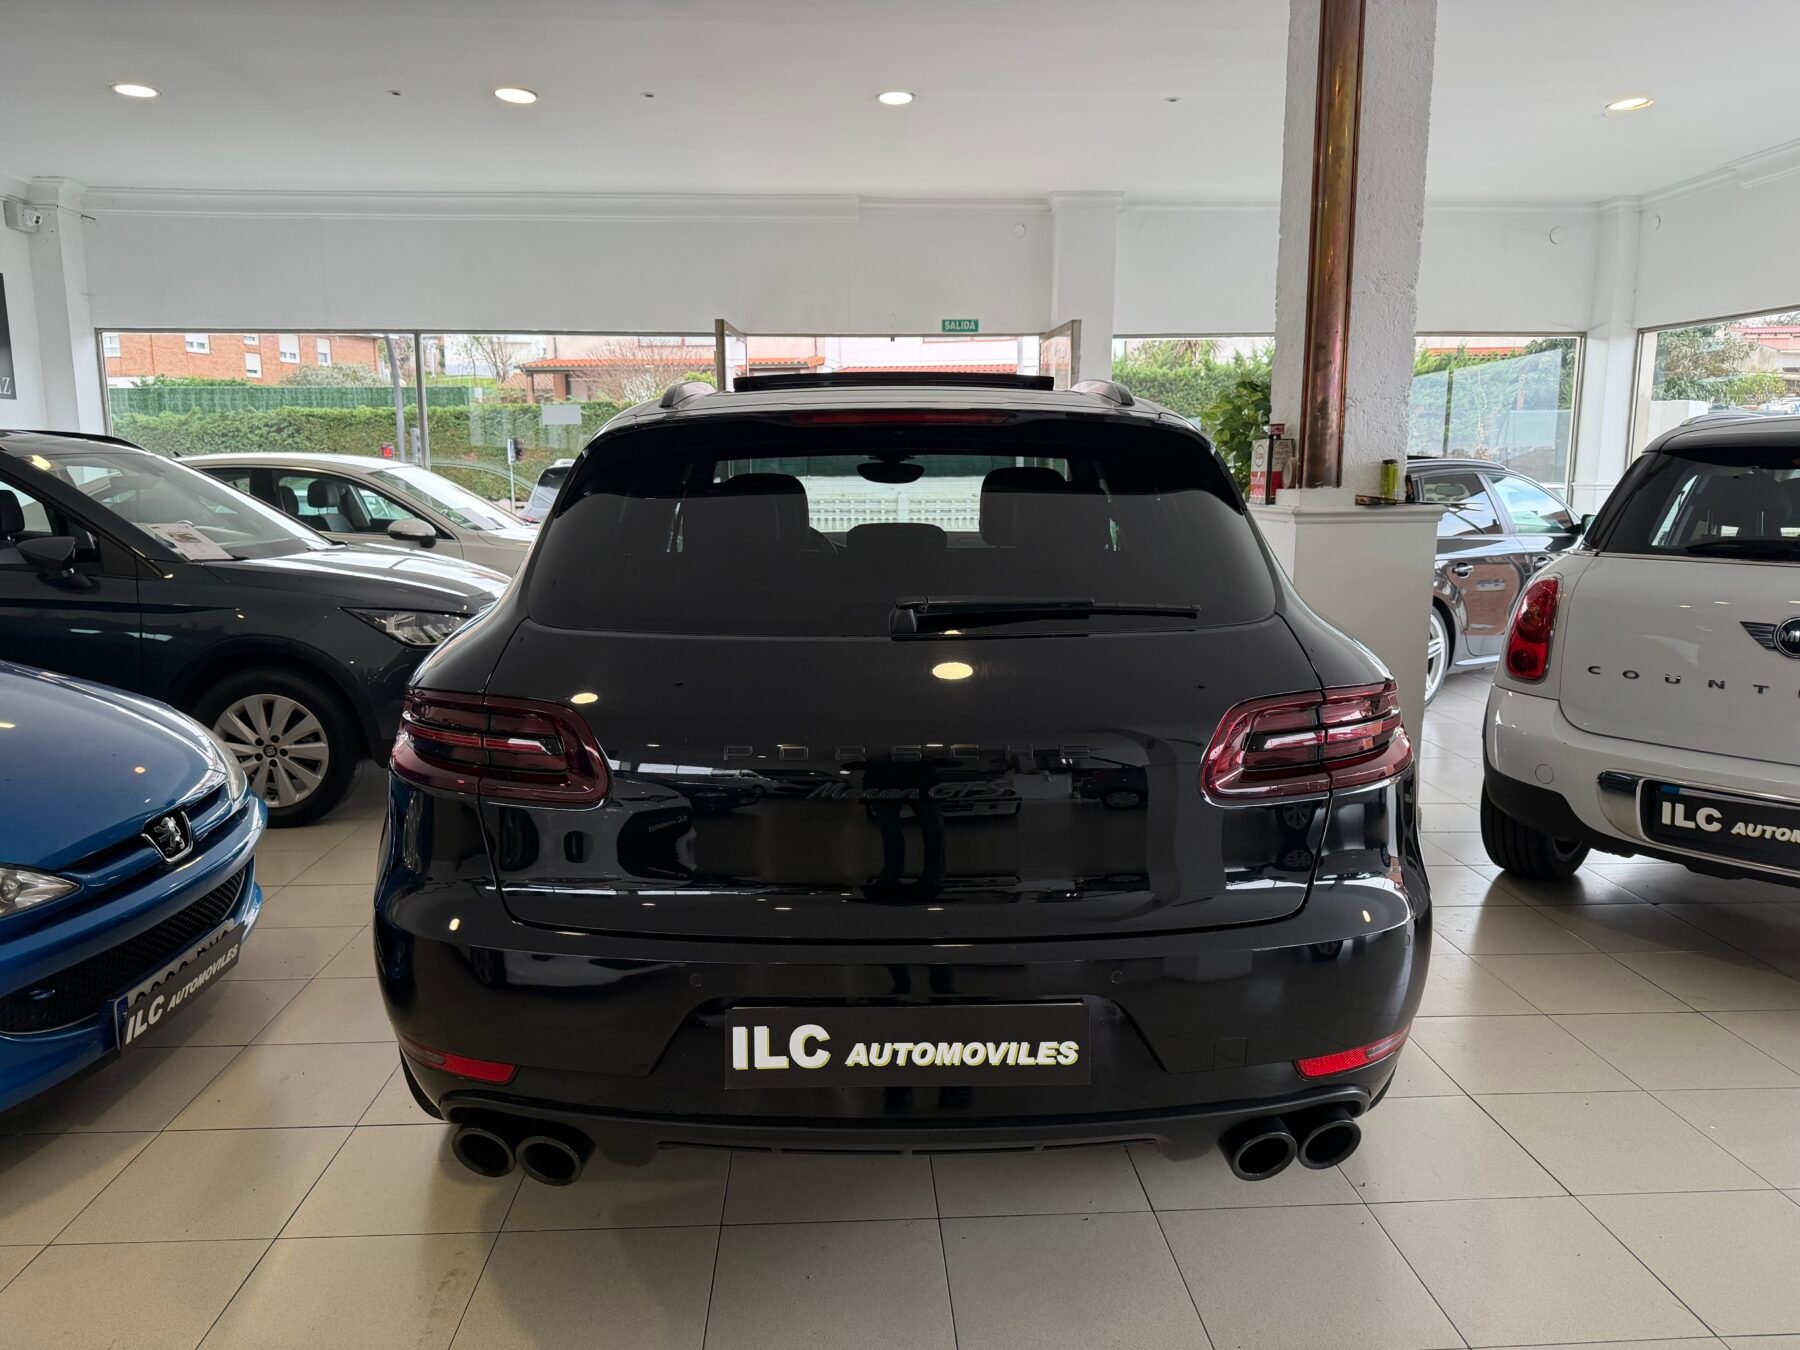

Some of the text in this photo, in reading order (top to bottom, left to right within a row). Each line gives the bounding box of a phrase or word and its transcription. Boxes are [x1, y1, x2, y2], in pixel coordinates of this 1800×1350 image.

[944, 319, 976, 330] SALIDA
[0, 376, 11, 395] Z
[1587, 664, 1800, 699] COUNT
[723, 743, 1091, 761] PORSCHE
[928, 780, 1018, 799] GTS
[1661, 800, 1722, 833] ILC
[125, 994, 165, 1045] ILC
[166, 943, 239, 1012] AUTOMOVILES
[732, 1024, 1080, 1070] ILC AUTOMOVILES
